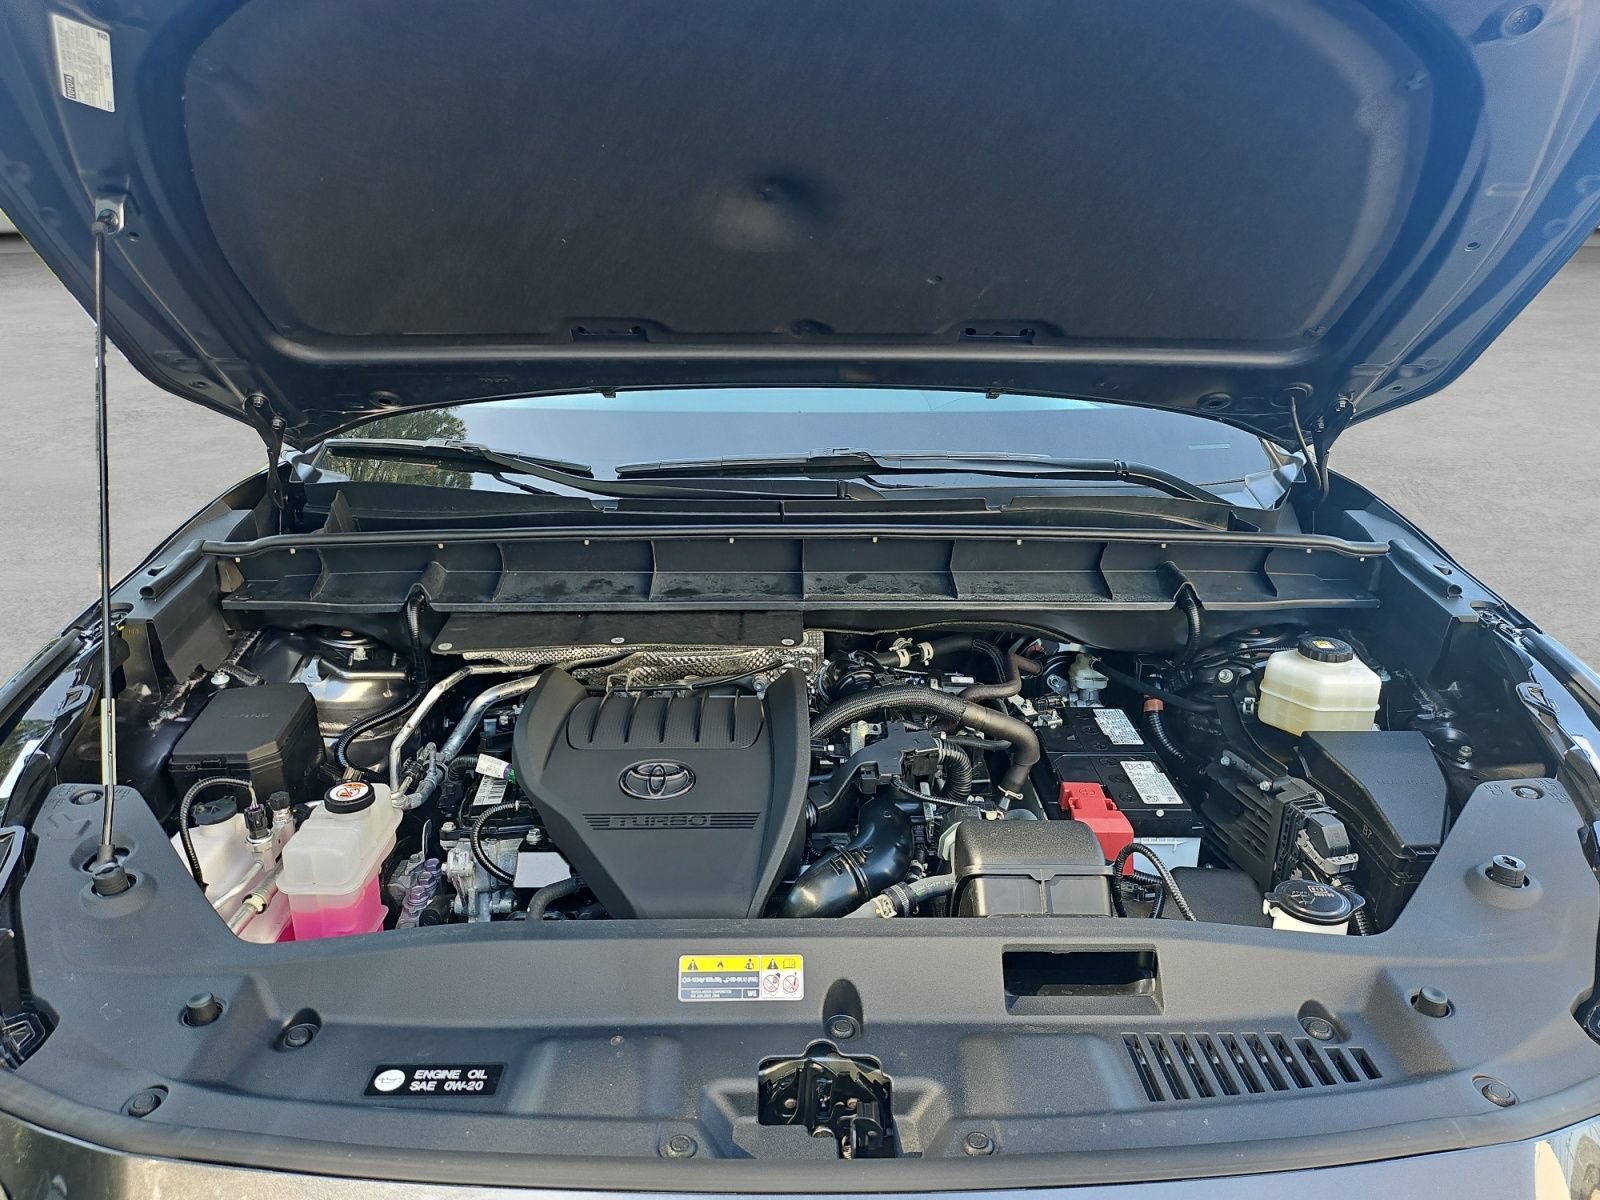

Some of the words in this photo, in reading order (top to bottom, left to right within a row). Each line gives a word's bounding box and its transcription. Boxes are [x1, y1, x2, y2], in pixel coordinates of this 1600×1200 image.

[610, 815, 707, 827] TURBO
[414, 1069, 461, 1079] ENGINE
[467, 1069, 488, 1080] OIL
[408, 1081, 437, 1092] SAE
[444, 1081, 484, 1092] 0W-20
